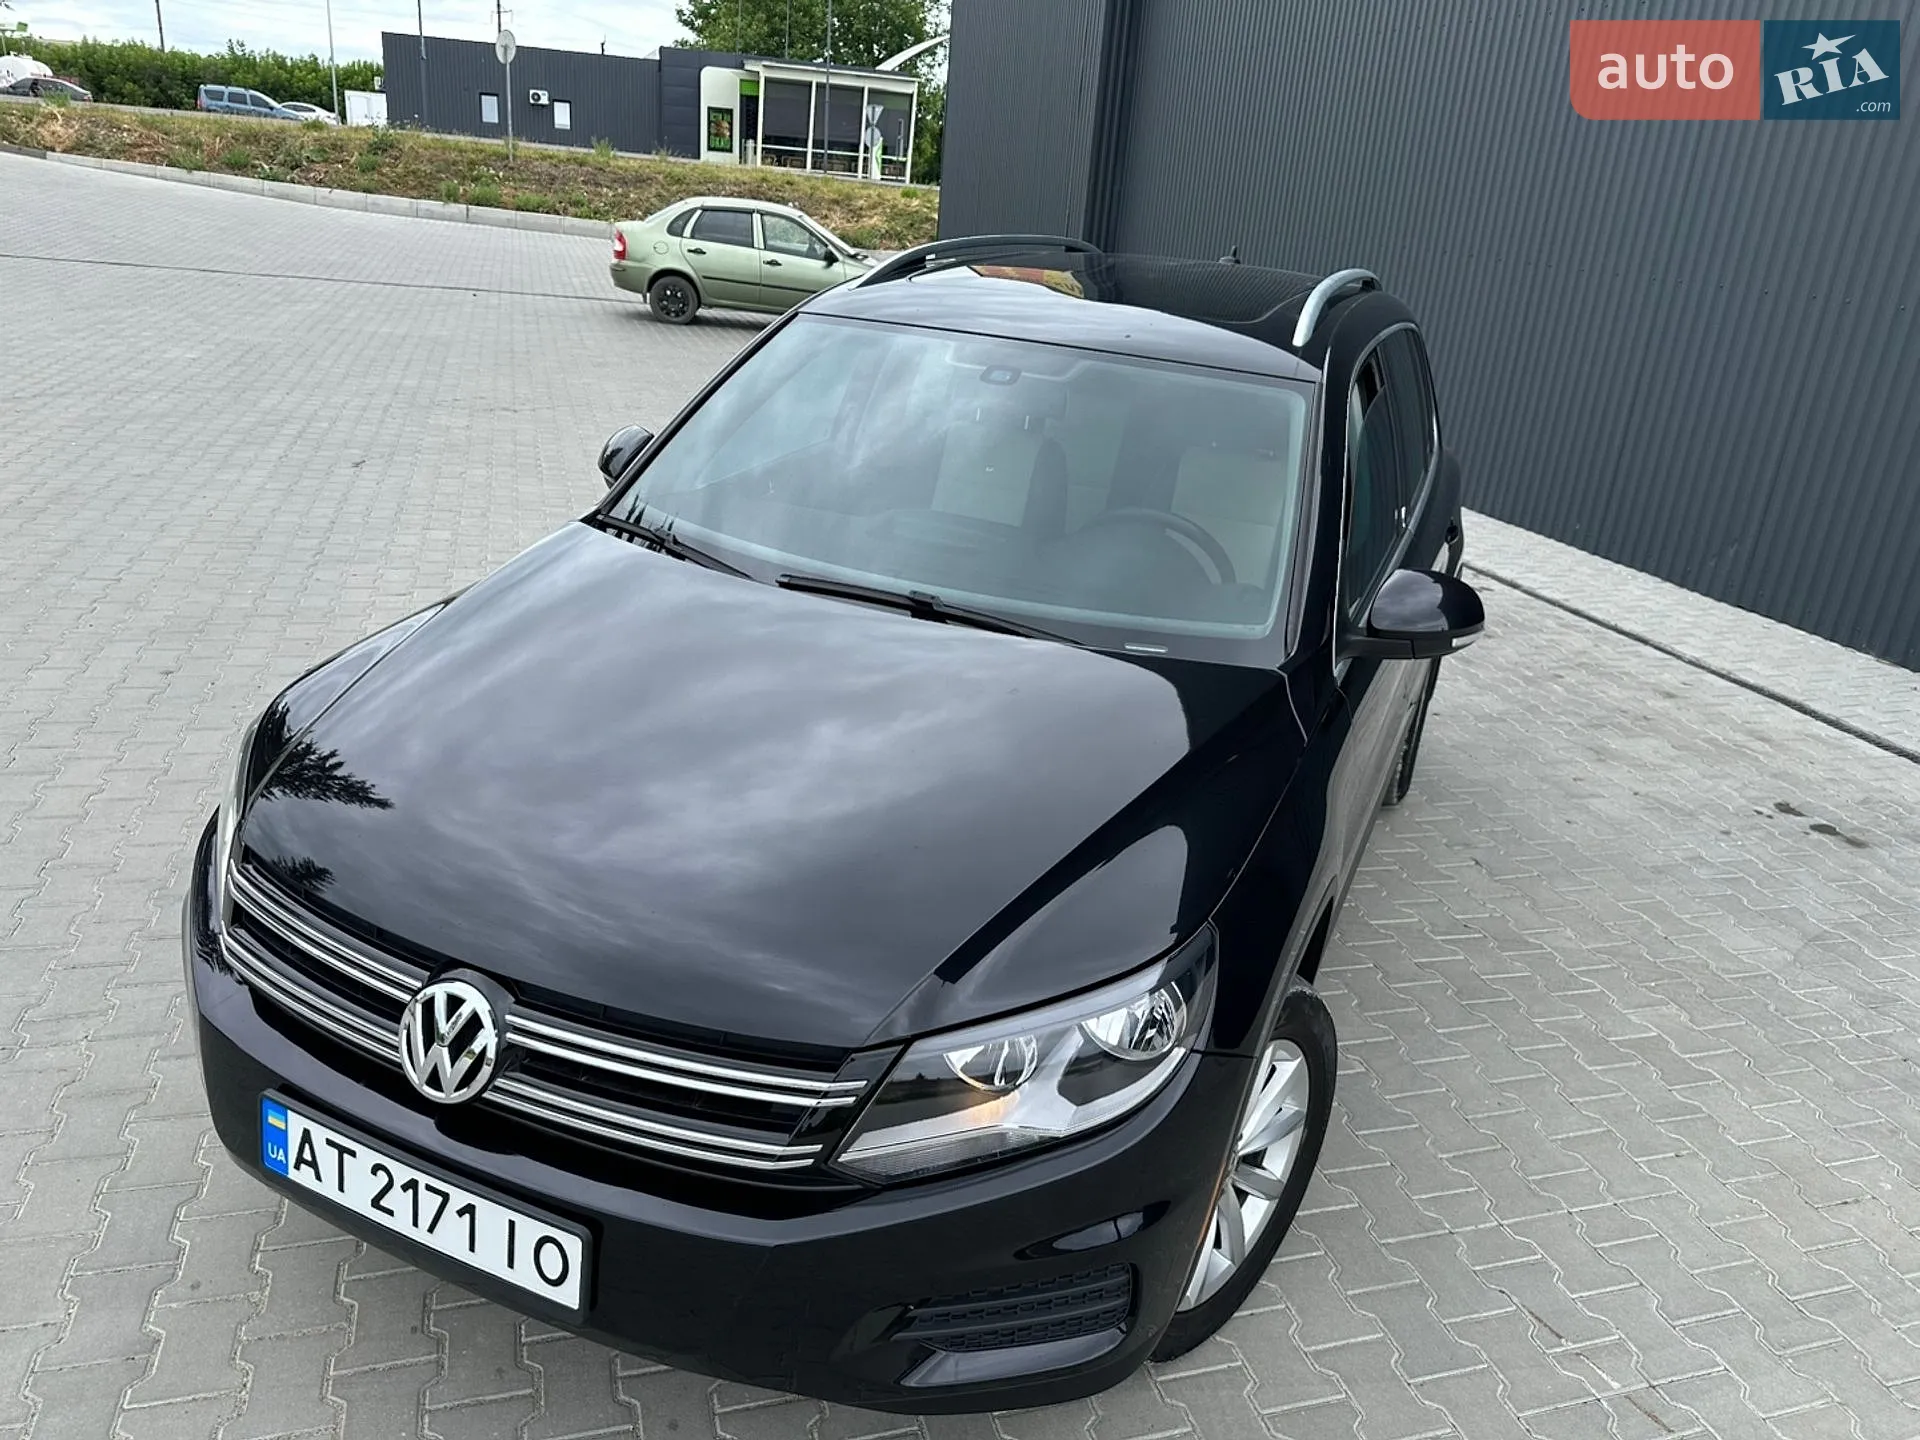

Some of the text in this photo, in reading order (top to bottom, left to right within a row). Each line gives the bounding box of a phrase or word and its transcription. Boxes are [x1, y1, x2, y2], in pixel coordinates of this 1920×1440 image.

[268, 1142, 287, 1165] UA
[293, 1127, 570, 1288] AT 2171 IO
